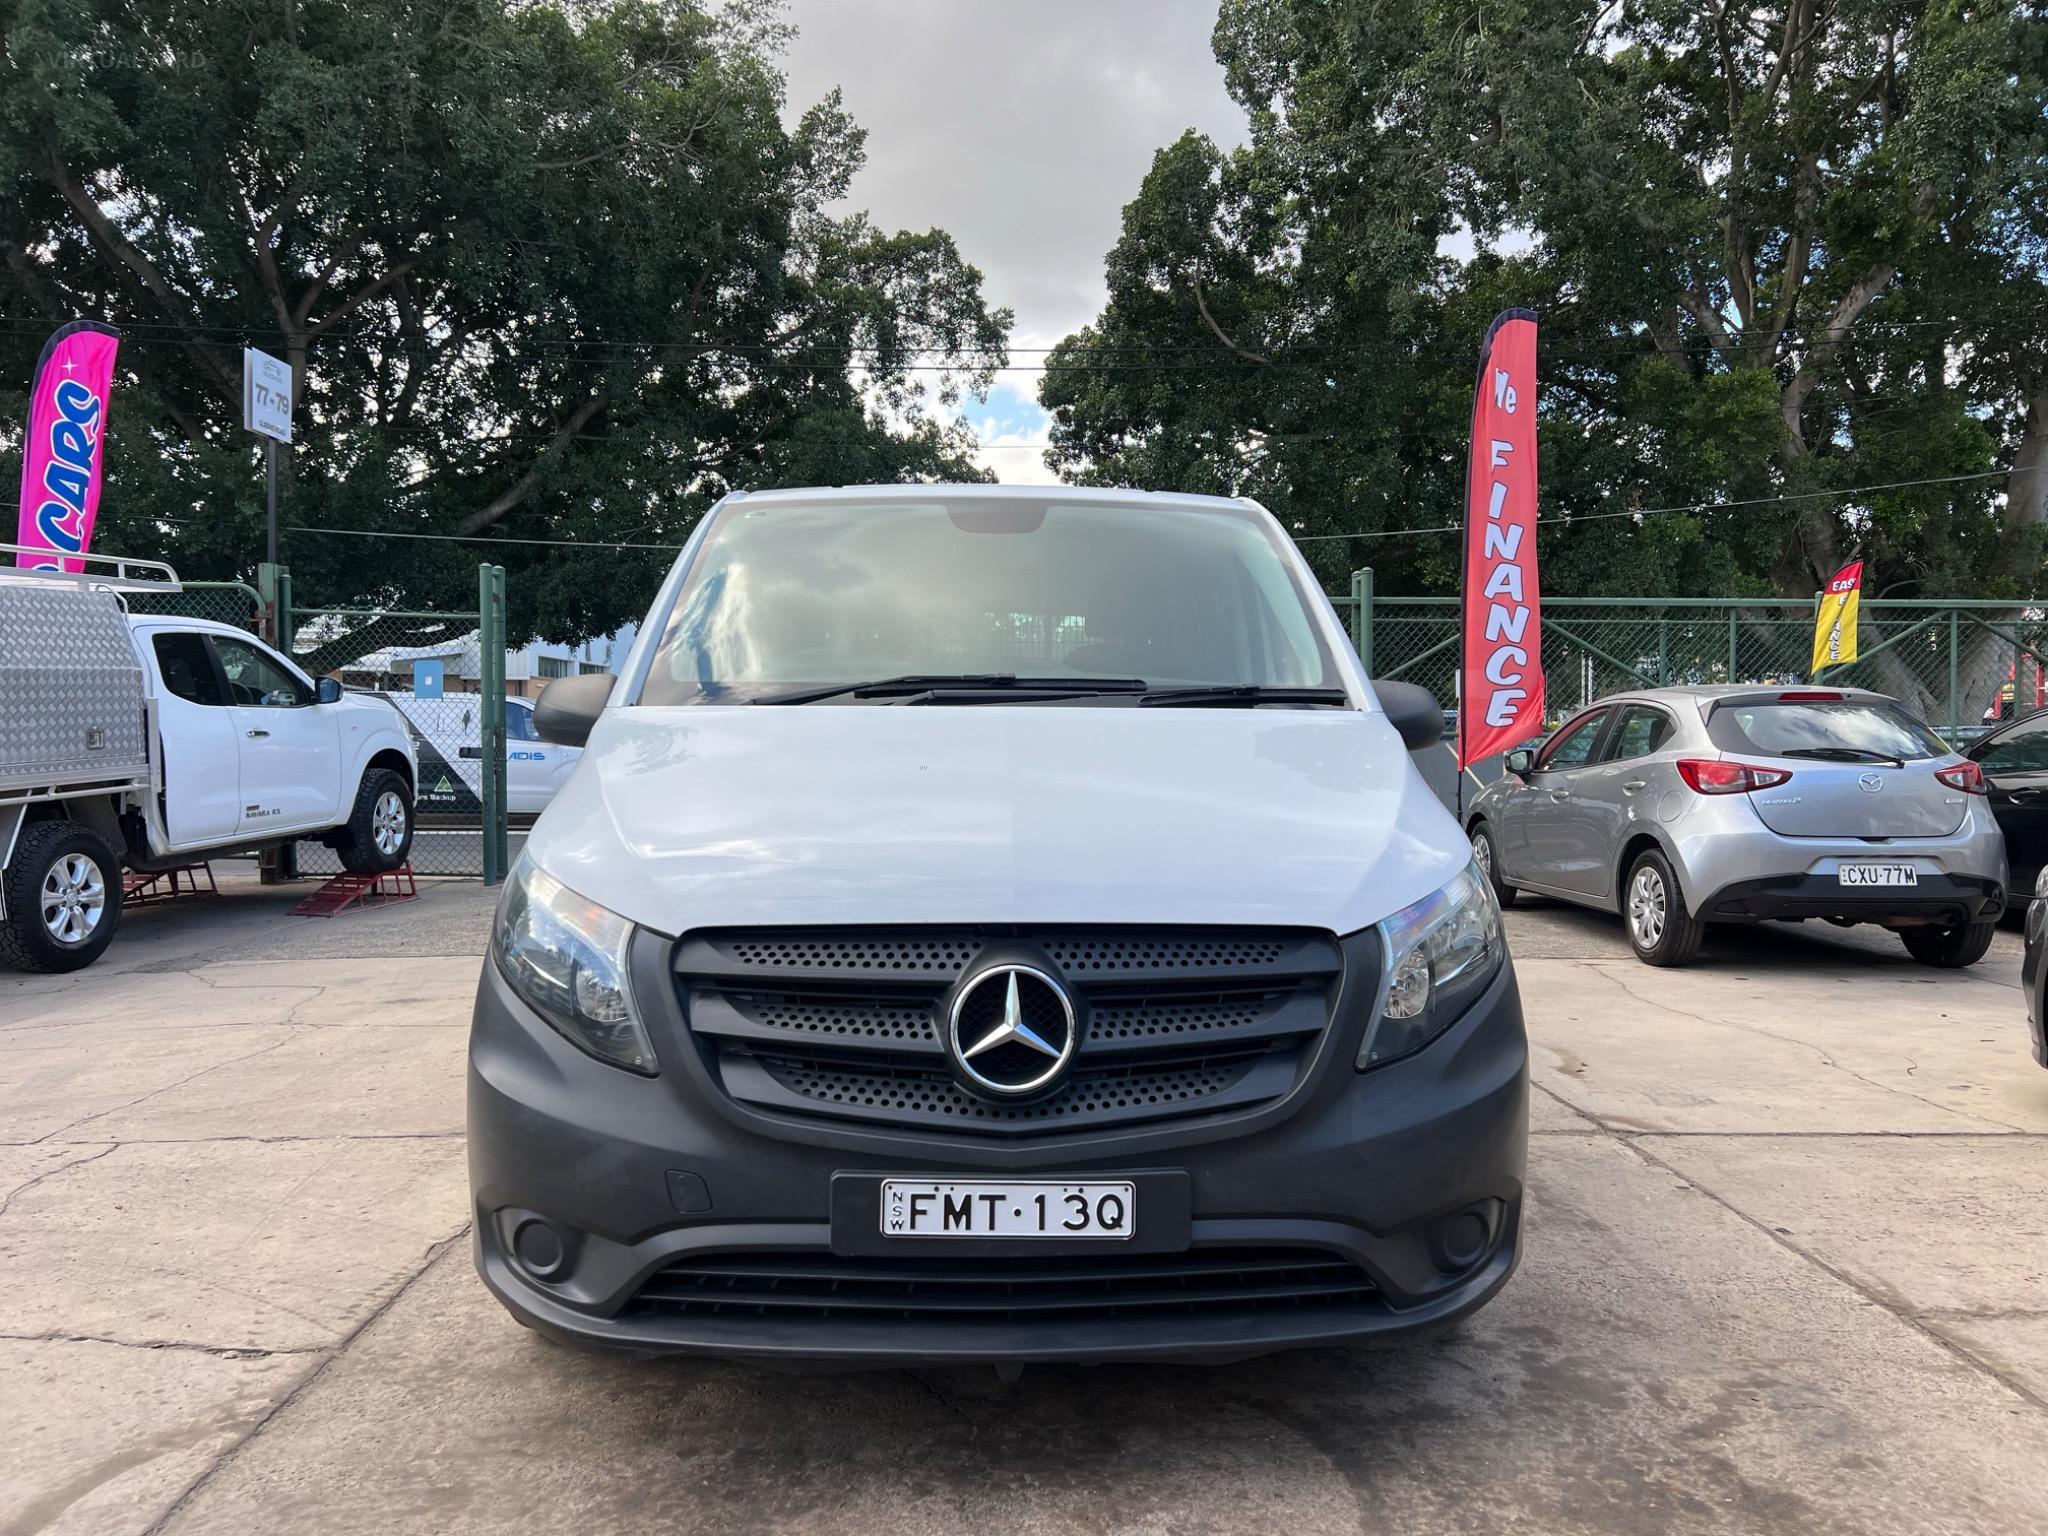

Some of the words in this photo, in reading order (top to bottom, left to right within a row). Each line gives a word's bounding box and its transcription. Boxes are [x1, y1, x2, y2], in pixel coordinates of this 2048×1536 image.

[255, 382, 290, 415] 77-79
[1484, 439, 1530, 728] FINANCE
[1832, 577, 1857, 592] EAS
[891, 1191, 905, 1231] NSW
